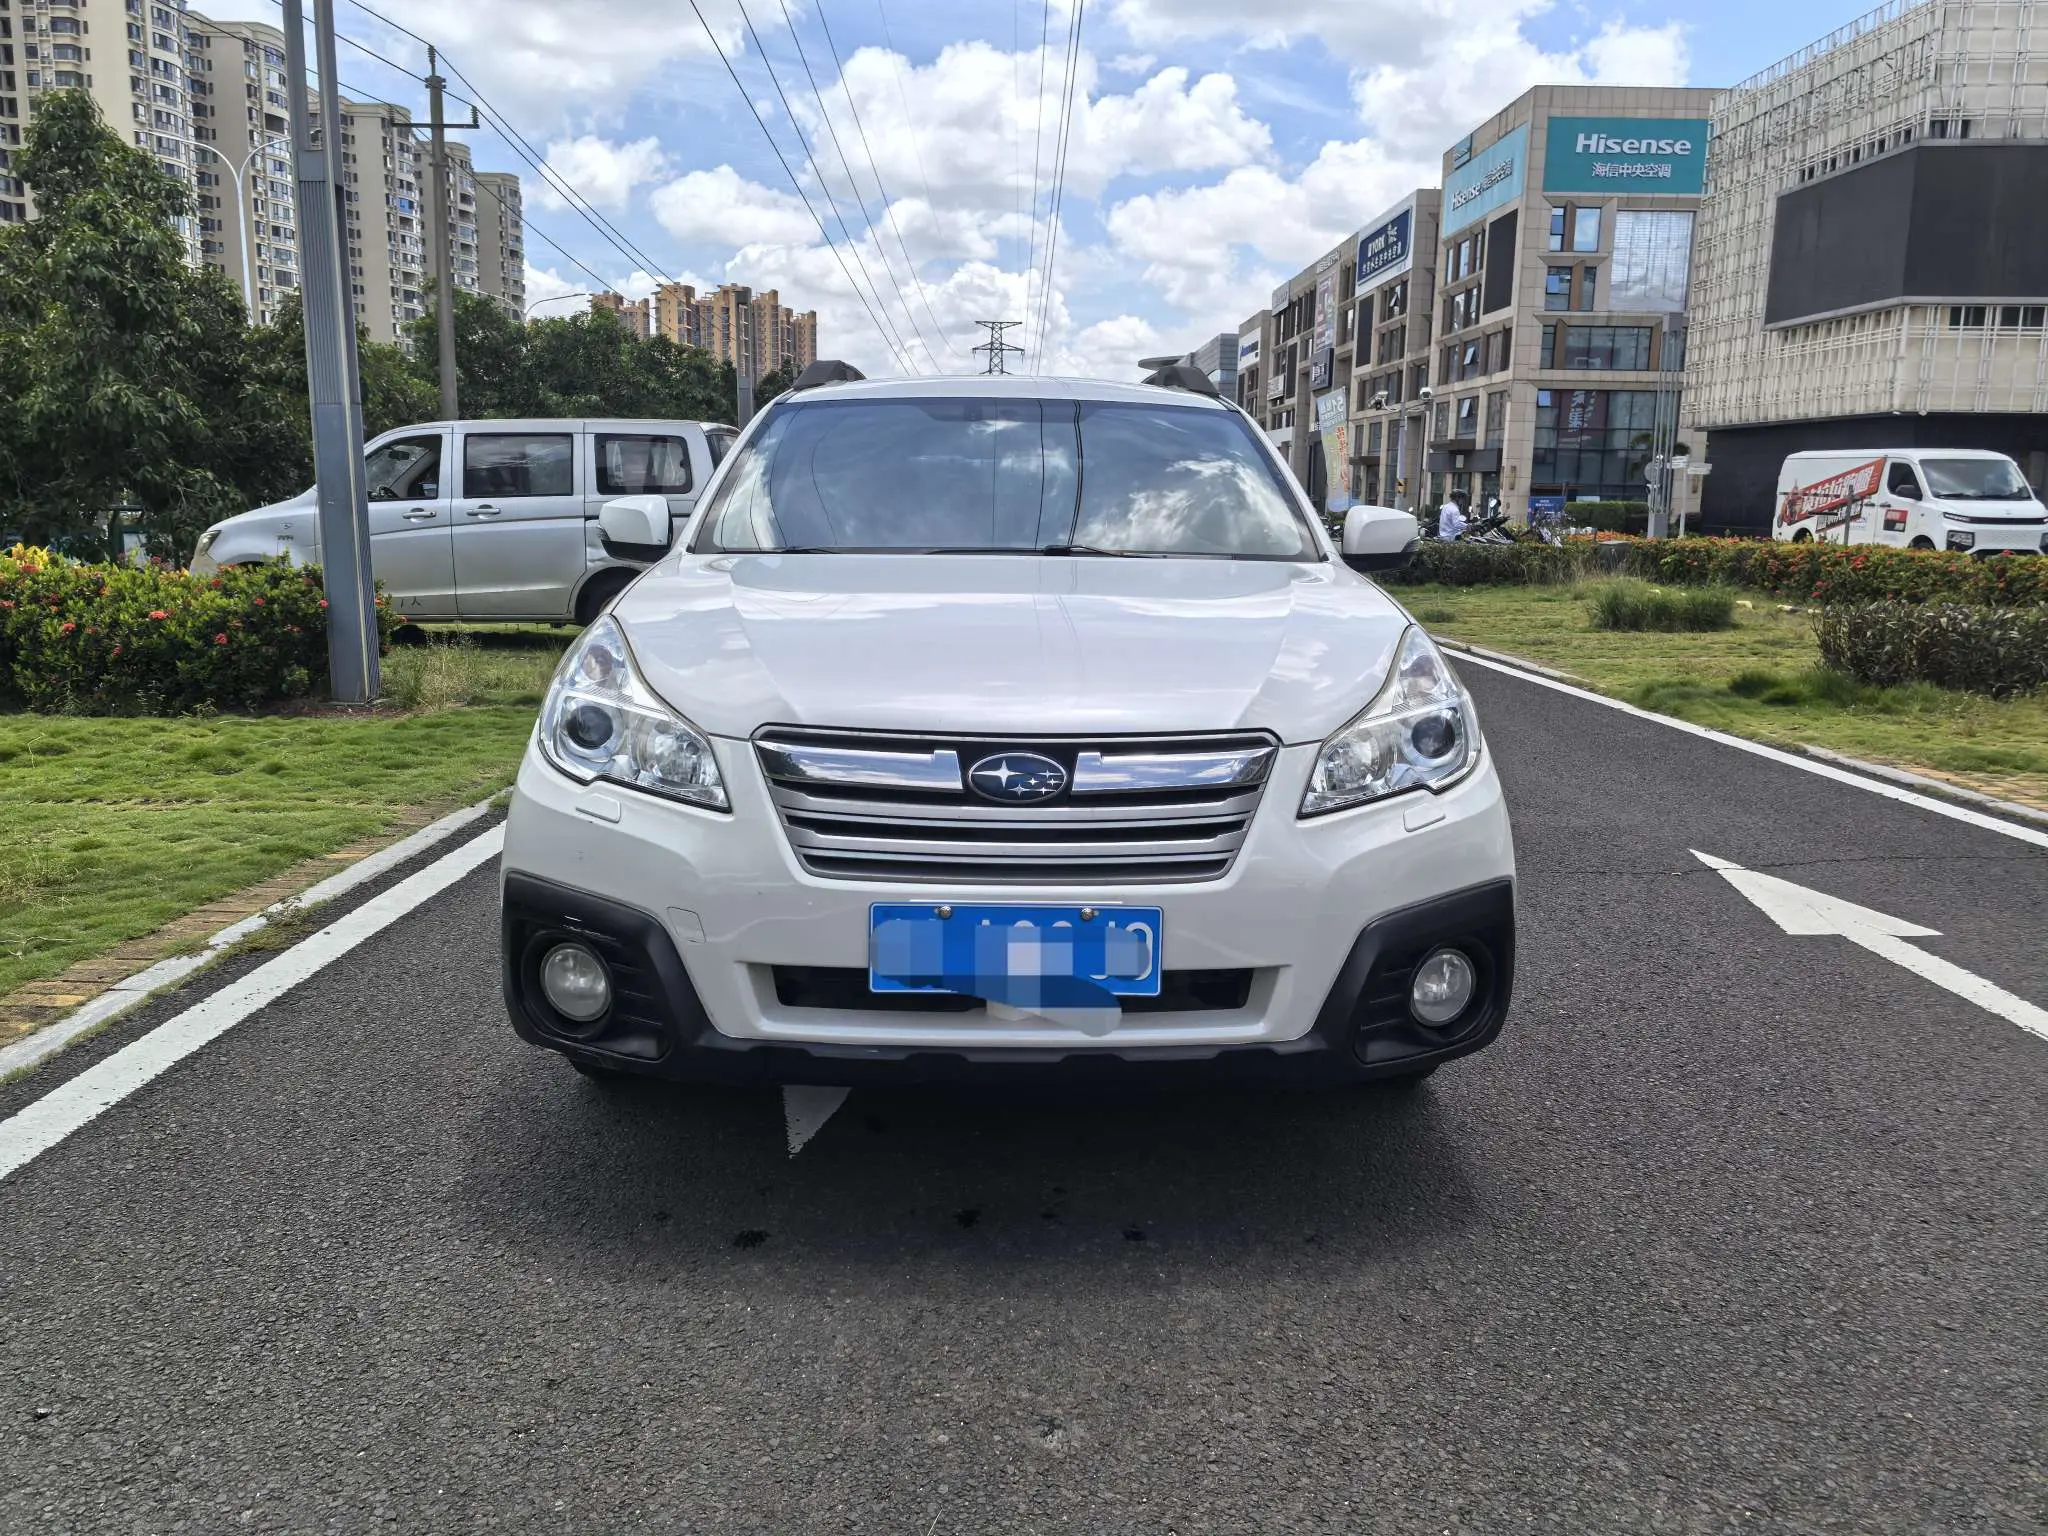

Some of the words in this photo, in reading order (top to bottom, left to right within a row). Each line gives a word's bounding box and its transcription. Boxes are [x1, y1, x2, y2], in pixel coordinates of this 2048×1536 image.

[1575, 132, 1692, 155] Hisense
[1591, 162, 1672, 178] 海信中央空调
